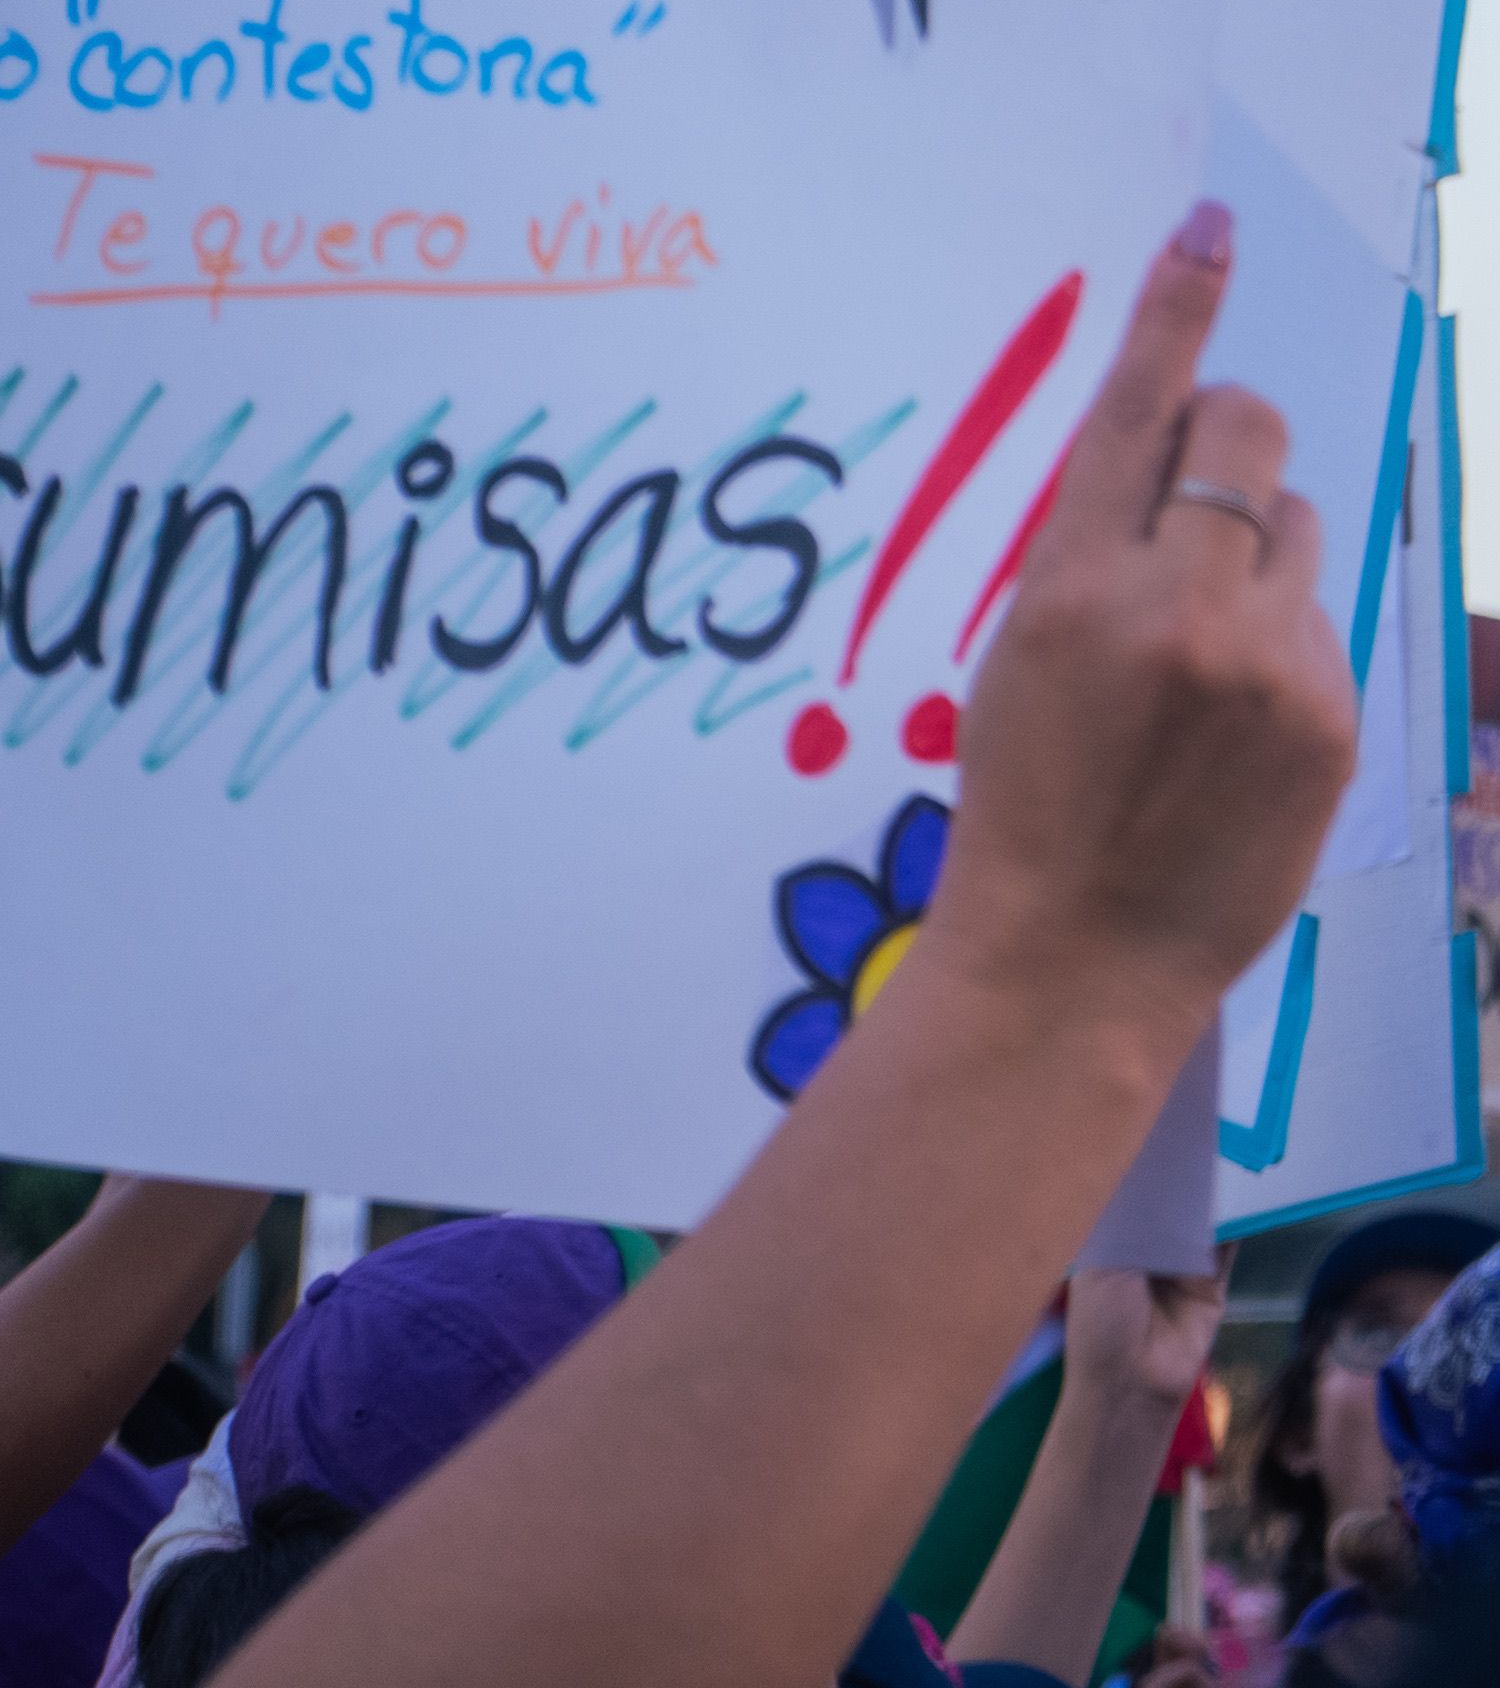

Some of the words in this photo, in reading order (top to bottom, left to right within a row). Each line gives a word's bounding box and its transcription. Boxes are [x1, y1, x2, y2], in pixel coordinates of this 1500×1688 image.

[32, 151, 156, 277] Te
[189, 204, 470, 318] quero
[527, 180, 721, 282] viva
